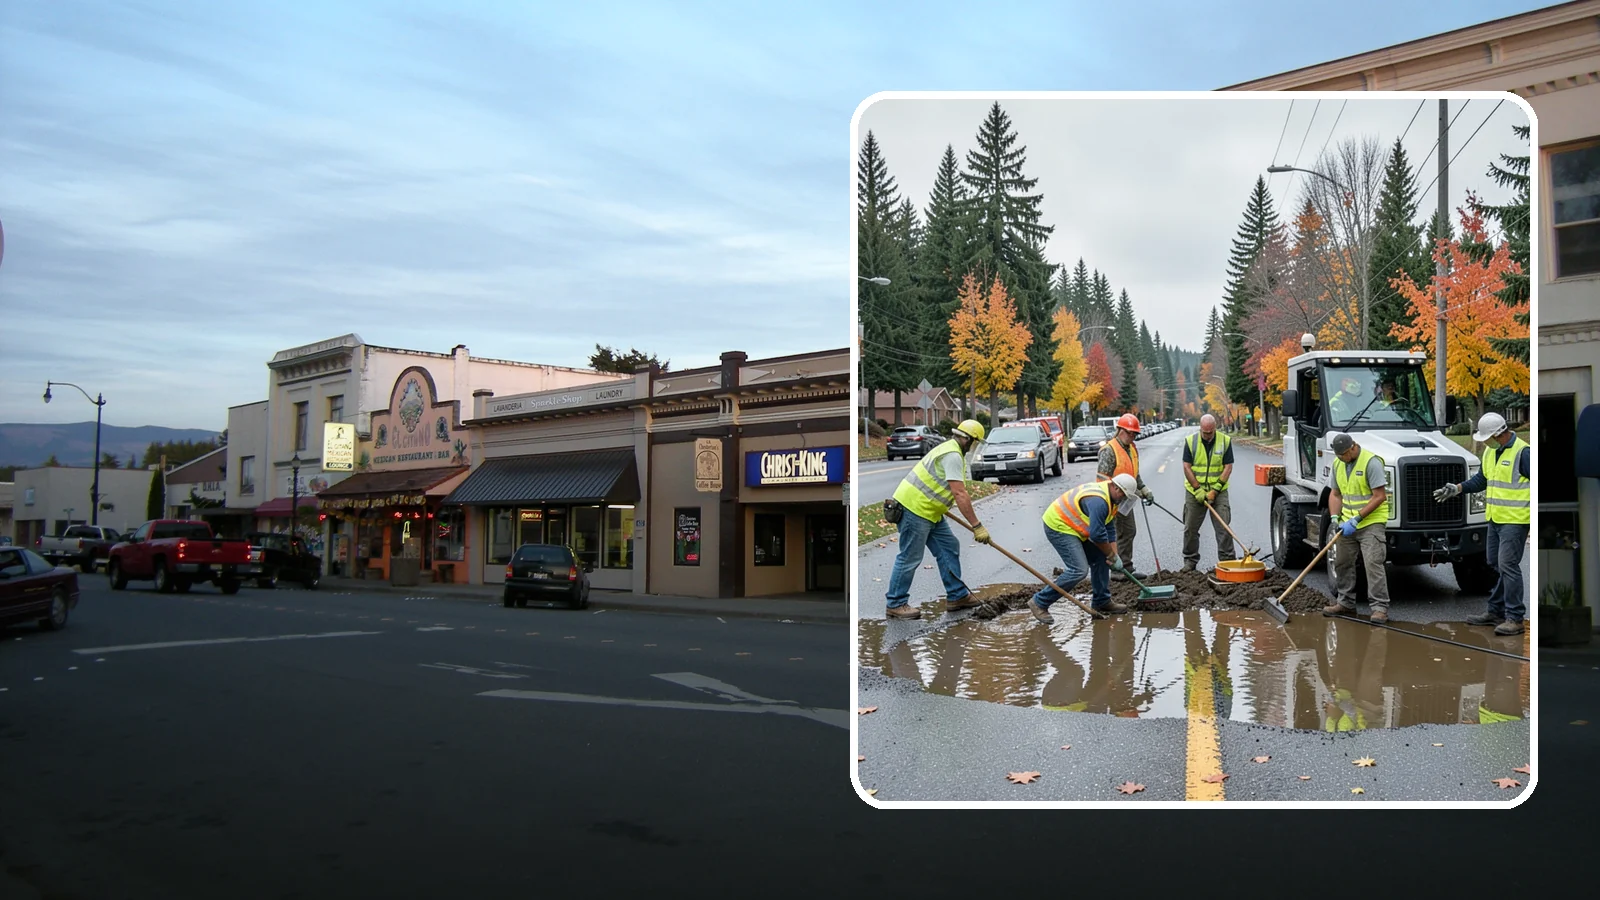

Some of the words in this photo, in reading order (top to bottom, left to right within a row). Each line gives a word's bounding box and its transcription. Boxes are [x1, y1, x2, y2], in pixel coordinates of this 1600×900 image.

[531, 399, 561, 409] Sparkle
[562, 394, 583, 406] Shop
[595, 389, 624, 400] LAUNDRY
[493, 402, 522, 412] LAVANDERIA
[373, 455, 396, 464] MEXICAN
[398, 451, 433, 462] RESTAURANT
[438, 450, 450, 459] BAR
[761, 452, 797, 478] CHRIST
[799, 450, 827, 476] KING
